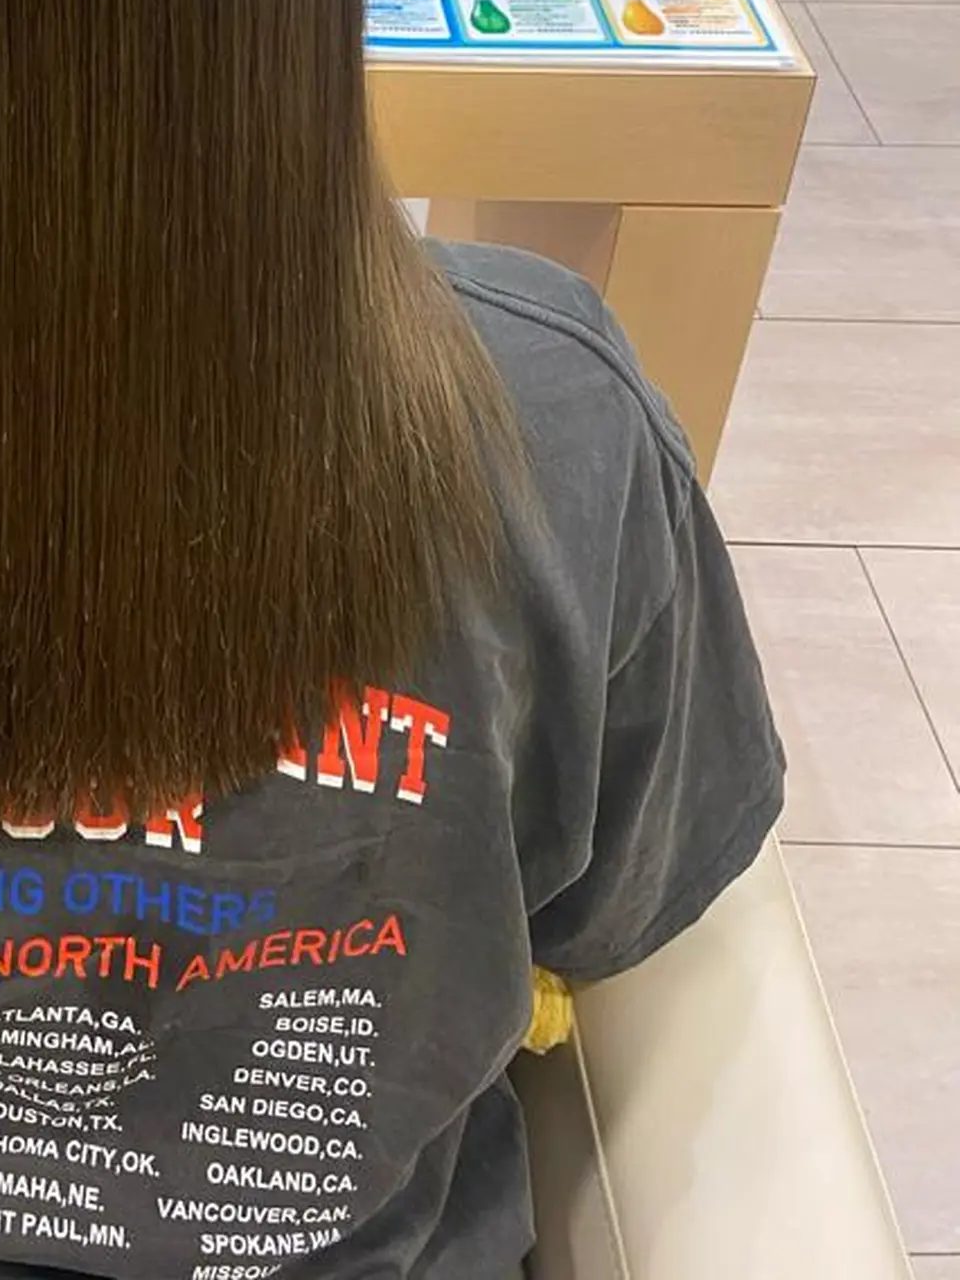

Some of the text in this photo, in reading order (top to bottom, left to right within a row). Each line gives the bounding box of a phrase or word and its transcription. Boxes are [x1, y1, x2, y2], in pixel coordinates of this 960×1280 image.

[176, 914, 406, 991] AMERICA
[258, 988, 382, 1009] SALEM,MA.
[275, 1017, 379, 1038] BOISE,ID.
[252, 1040, 376, 1068] OGDEN,UT.
[233, 1067, 373, 1098] DENVER,CO.
[200, 1093, 368, 1129] SAN DIEGO,CA.
[65, 1139, 160, 1177] CITY,OK.
[181, 1121, 364, 1161] INGLEWOOD,CA.
[206, 1162, 358, 1196] OAKLAND,CA.
[157, 1198, 352, 1226] VANCOUVER,CAN.
[21, 1212, 131, 1249] PAUL,MN.
